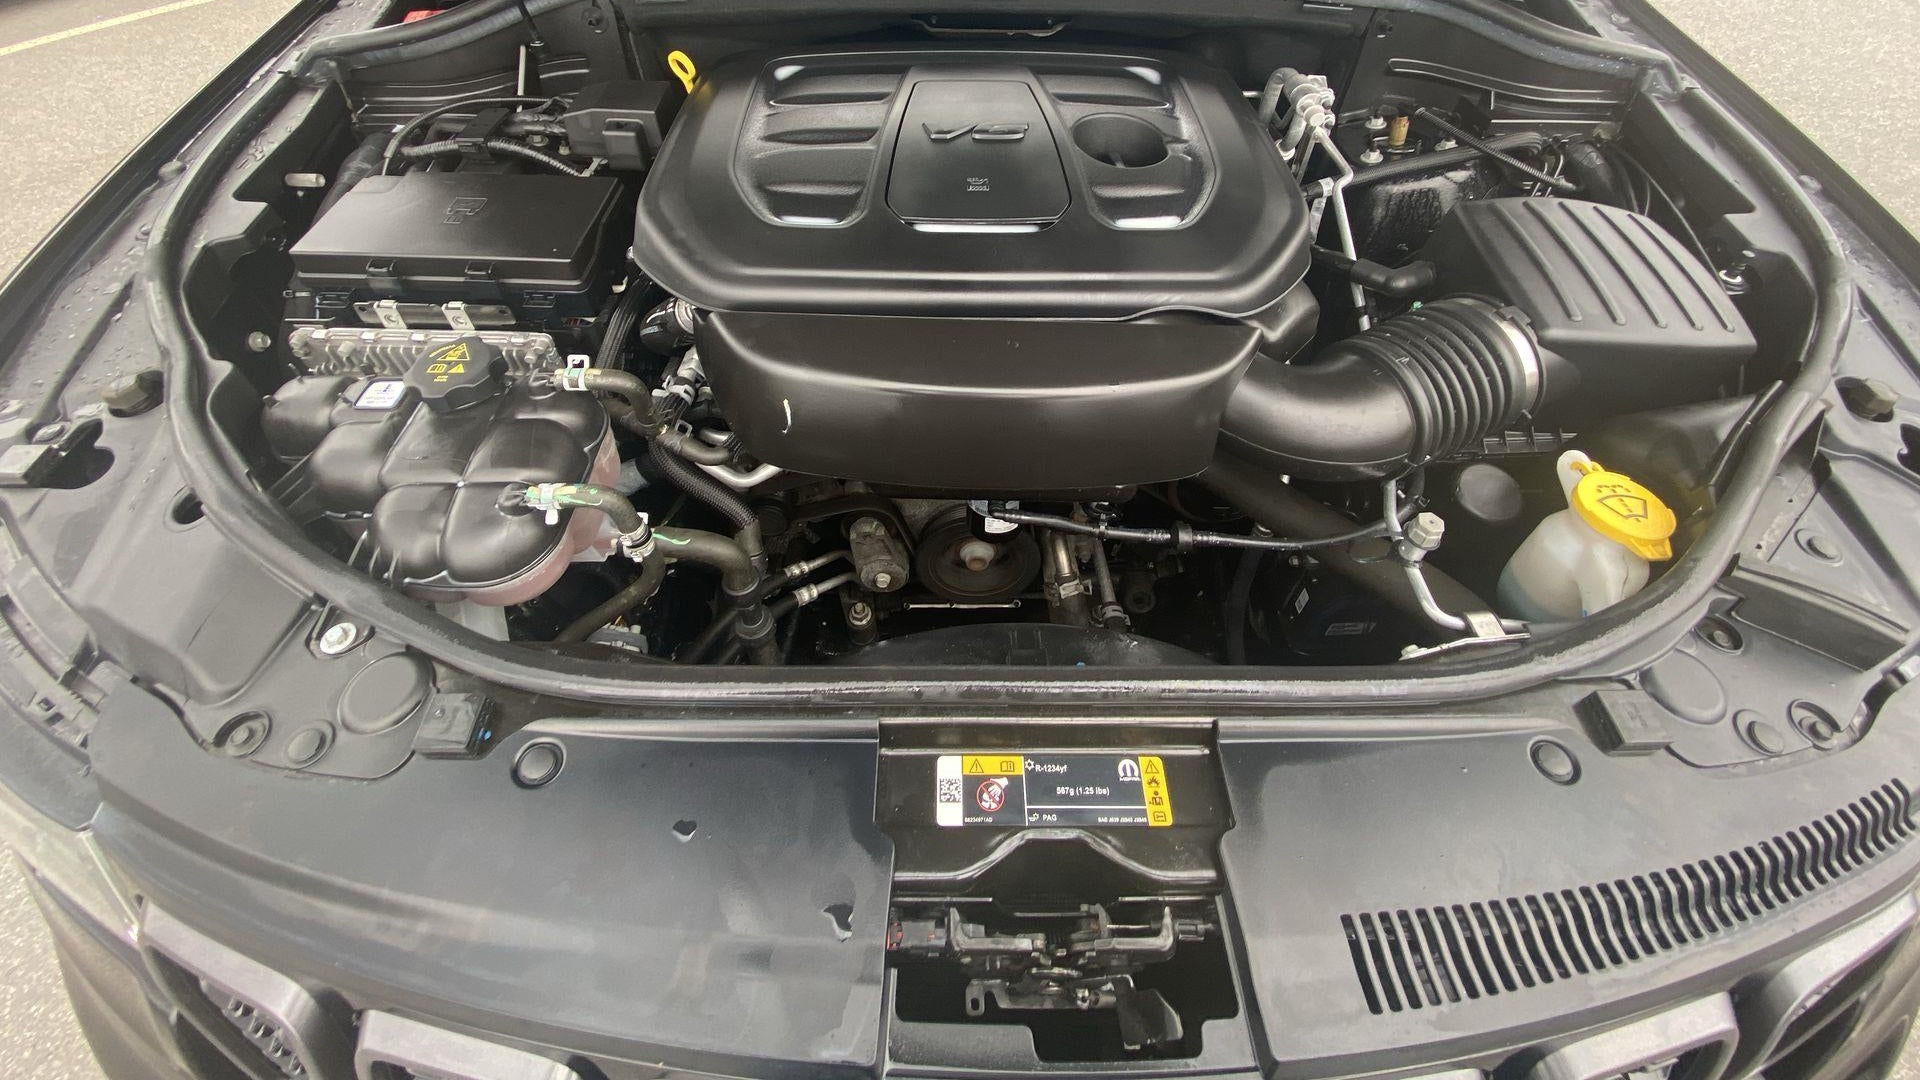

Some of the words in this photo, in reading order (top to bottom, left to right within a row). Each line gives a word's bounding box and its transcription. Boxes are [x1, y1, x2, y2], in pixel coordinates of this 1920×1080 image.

[921, 121, 1029, 141] V6
[1035, 764, 1068, 774] R-1234yf
[1076, 787, 1094, 796] (1.25
[1095, 787, 1110, 796] lbs)
